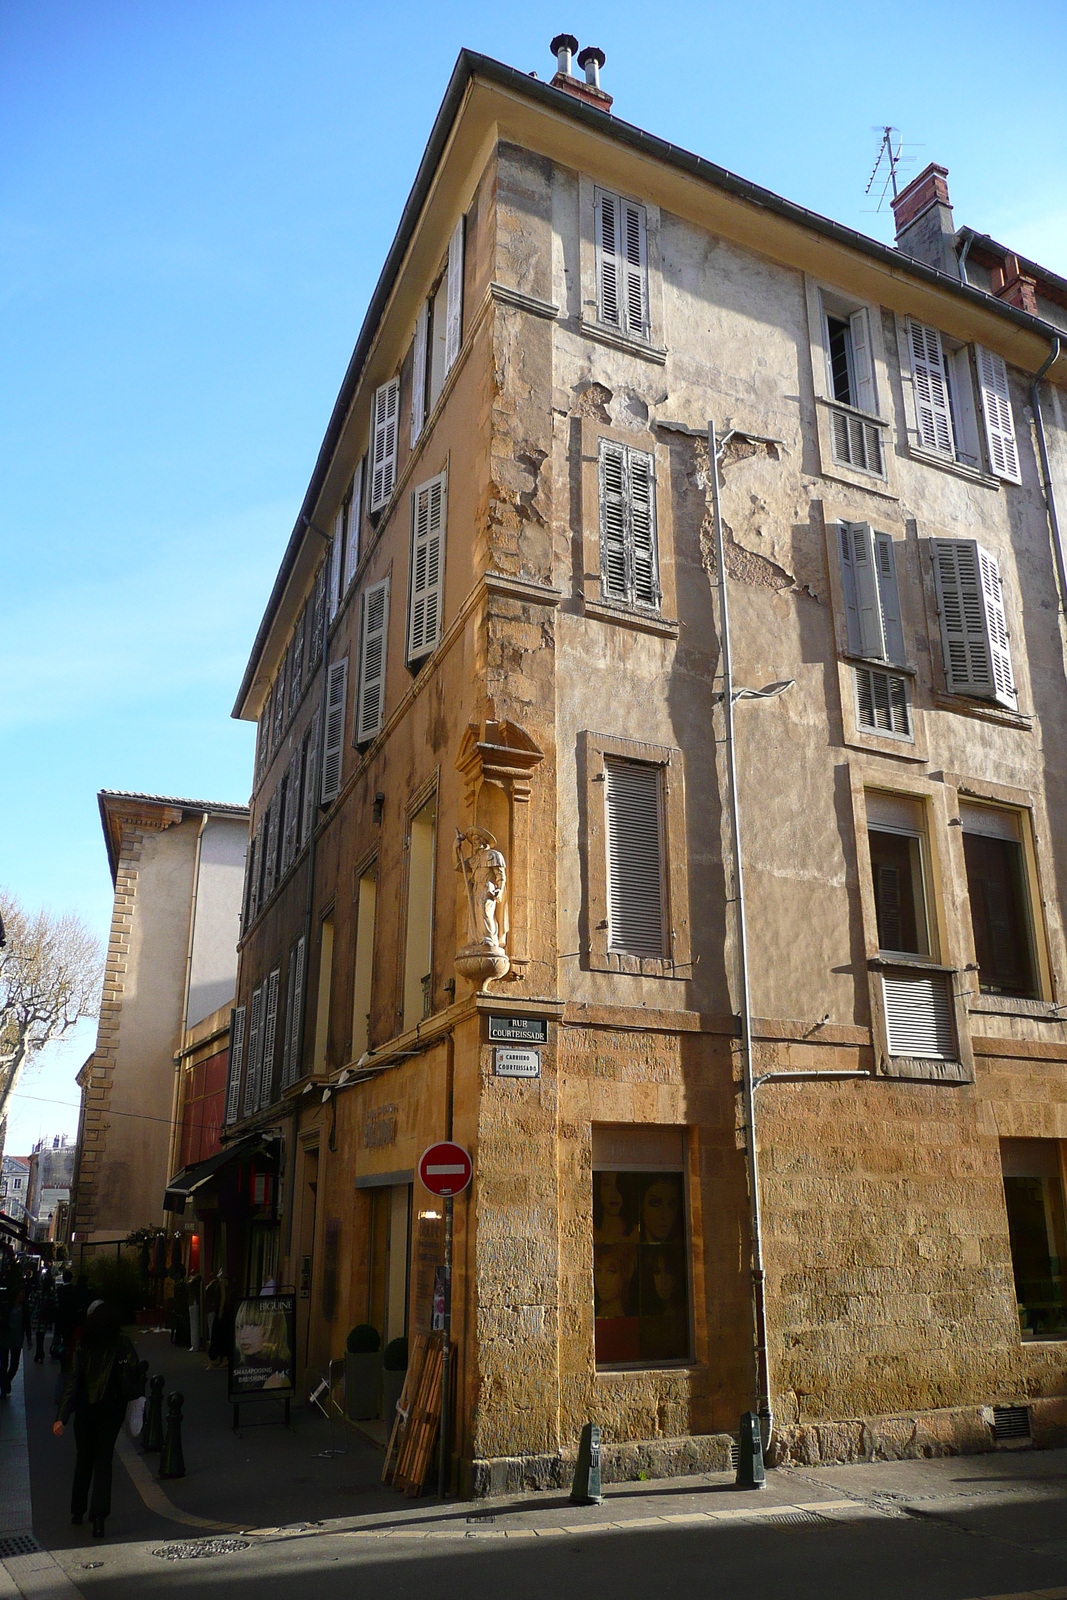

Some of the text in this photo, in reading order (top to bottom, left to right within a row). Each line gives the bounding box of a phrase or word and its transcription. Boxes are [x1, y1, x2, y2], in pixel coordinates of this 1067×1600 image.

[512, 1019, 528, 1028] RUE
[492, 1029, 544, 1040] COURTEISSADE
[259, 1301, 293, 1311] BIGUINE
[233, 1366, 273, 1376] SHAMPOOING
